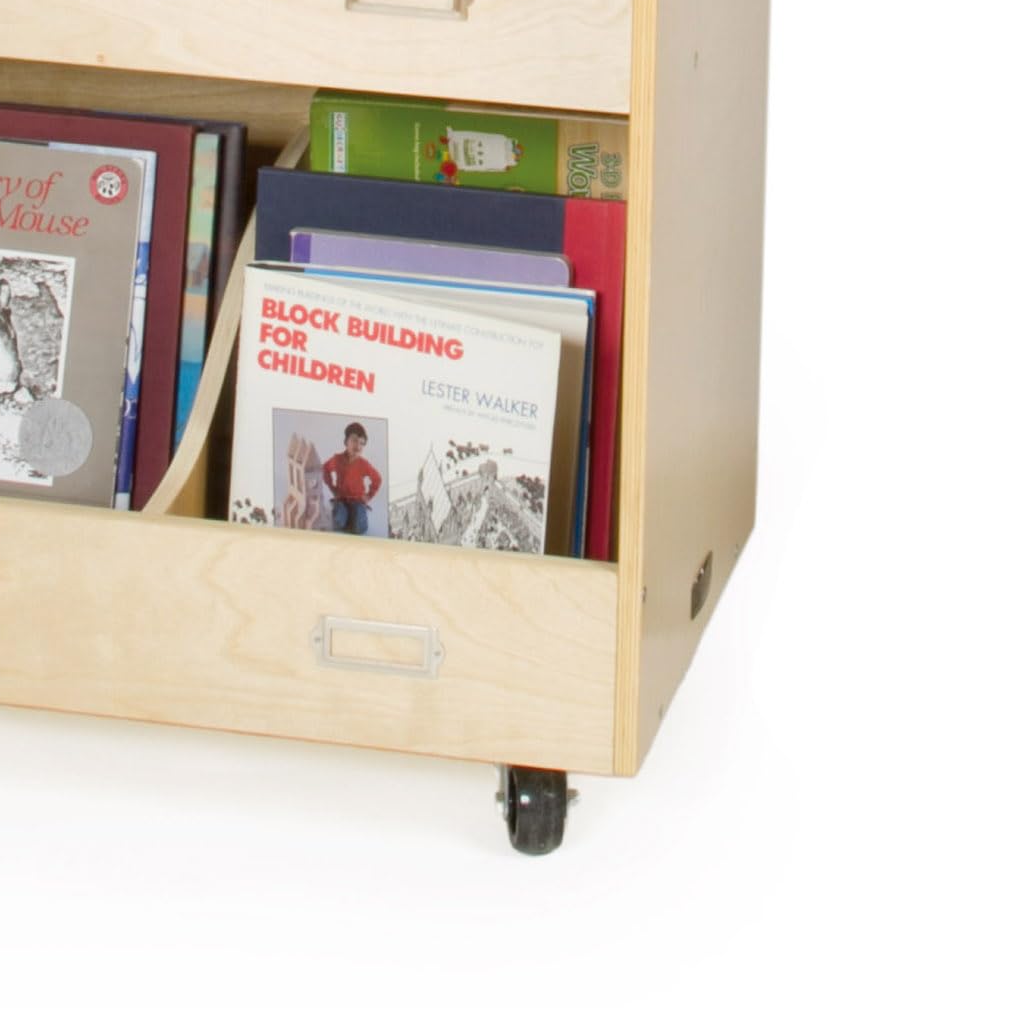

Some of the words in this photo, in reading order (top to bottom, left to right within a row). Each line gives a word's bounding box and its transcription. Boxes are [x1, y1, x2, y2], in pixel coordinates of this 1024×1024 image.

[25, 171, 63, 208] of
[259, 323, 308, 352] FOR
[262, 297, 340, 333] BLOCK
[347, 316, 464, 360] BUILDING
[257, 349, 375, 394] CHILDREN
[421, 379, 470, 404] LESTER
[475, 391, 538, 419] WALKER
